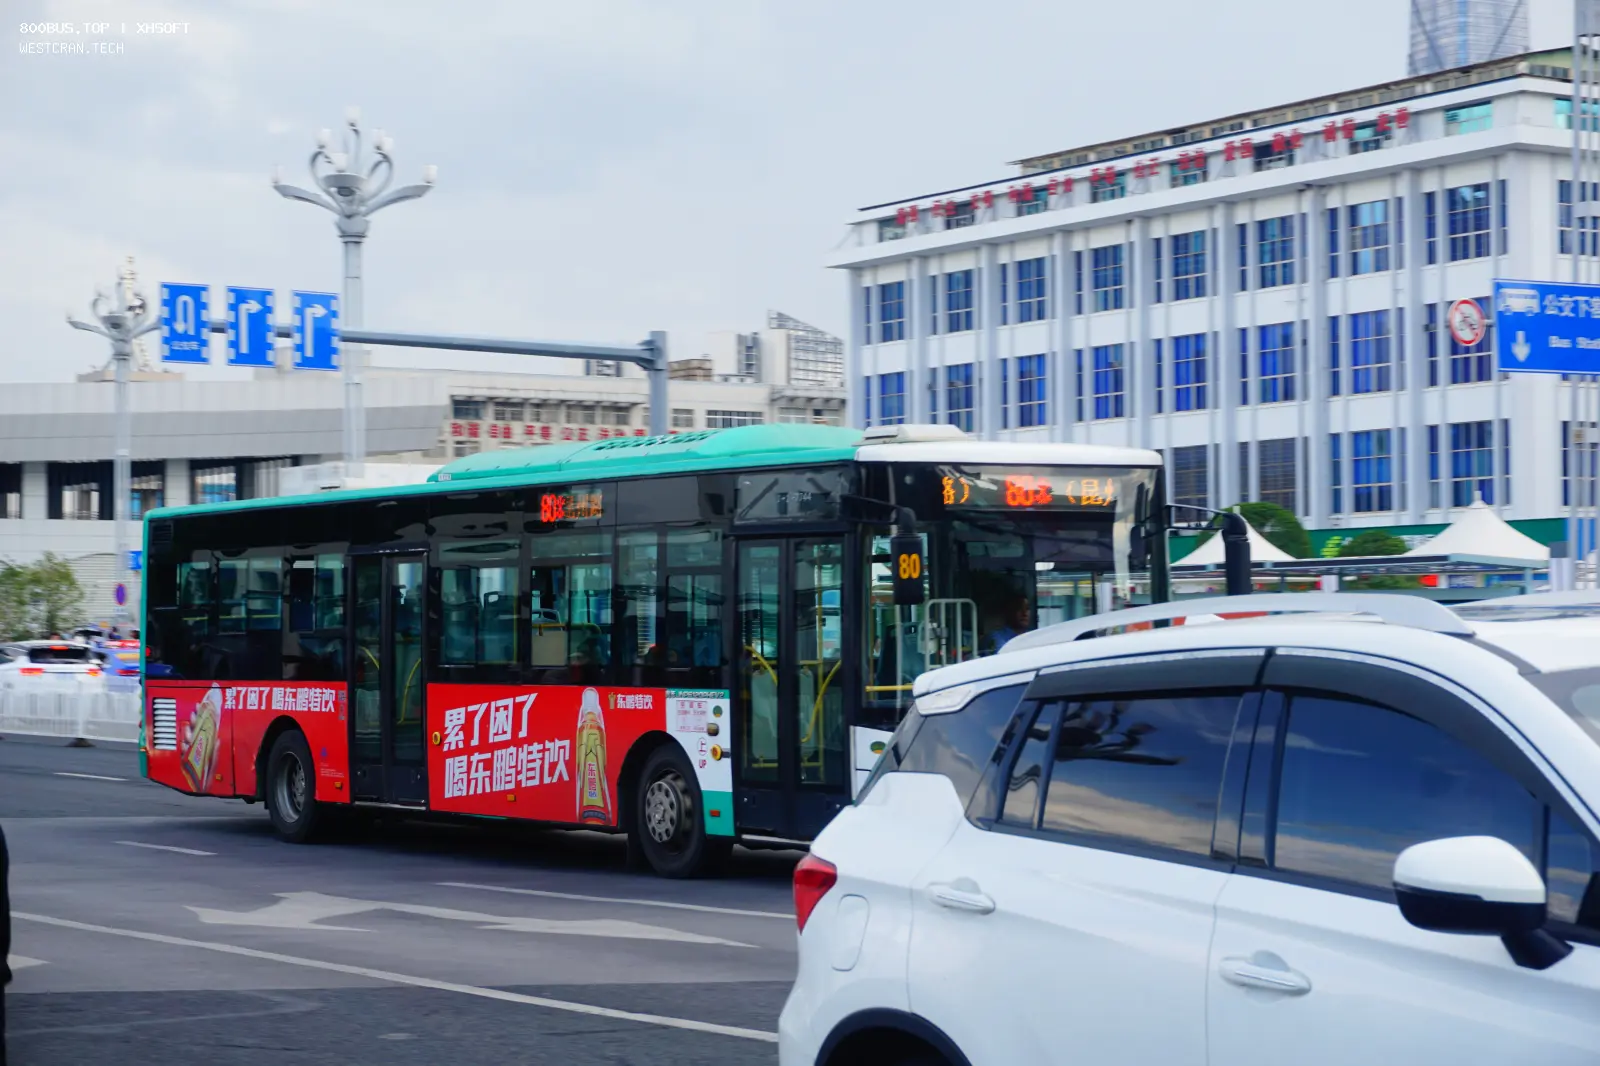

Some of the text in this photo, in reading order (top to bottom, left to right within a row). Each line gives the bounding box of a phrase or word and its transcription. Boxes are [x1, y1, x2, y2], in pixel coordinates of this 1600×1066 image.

[899, 553, 921, 579] 80
[224, 687, 271, 710] 累了困了
[271, 687, 336, 712] 喝东鹏特饮
[616, 693, 654, 710] 东鹏特饮
[442, 692, 539, 752] 累了困了
[444, 738, 571, 798] 喝东鹏特饮
[698, 759, 707, 769] UP
